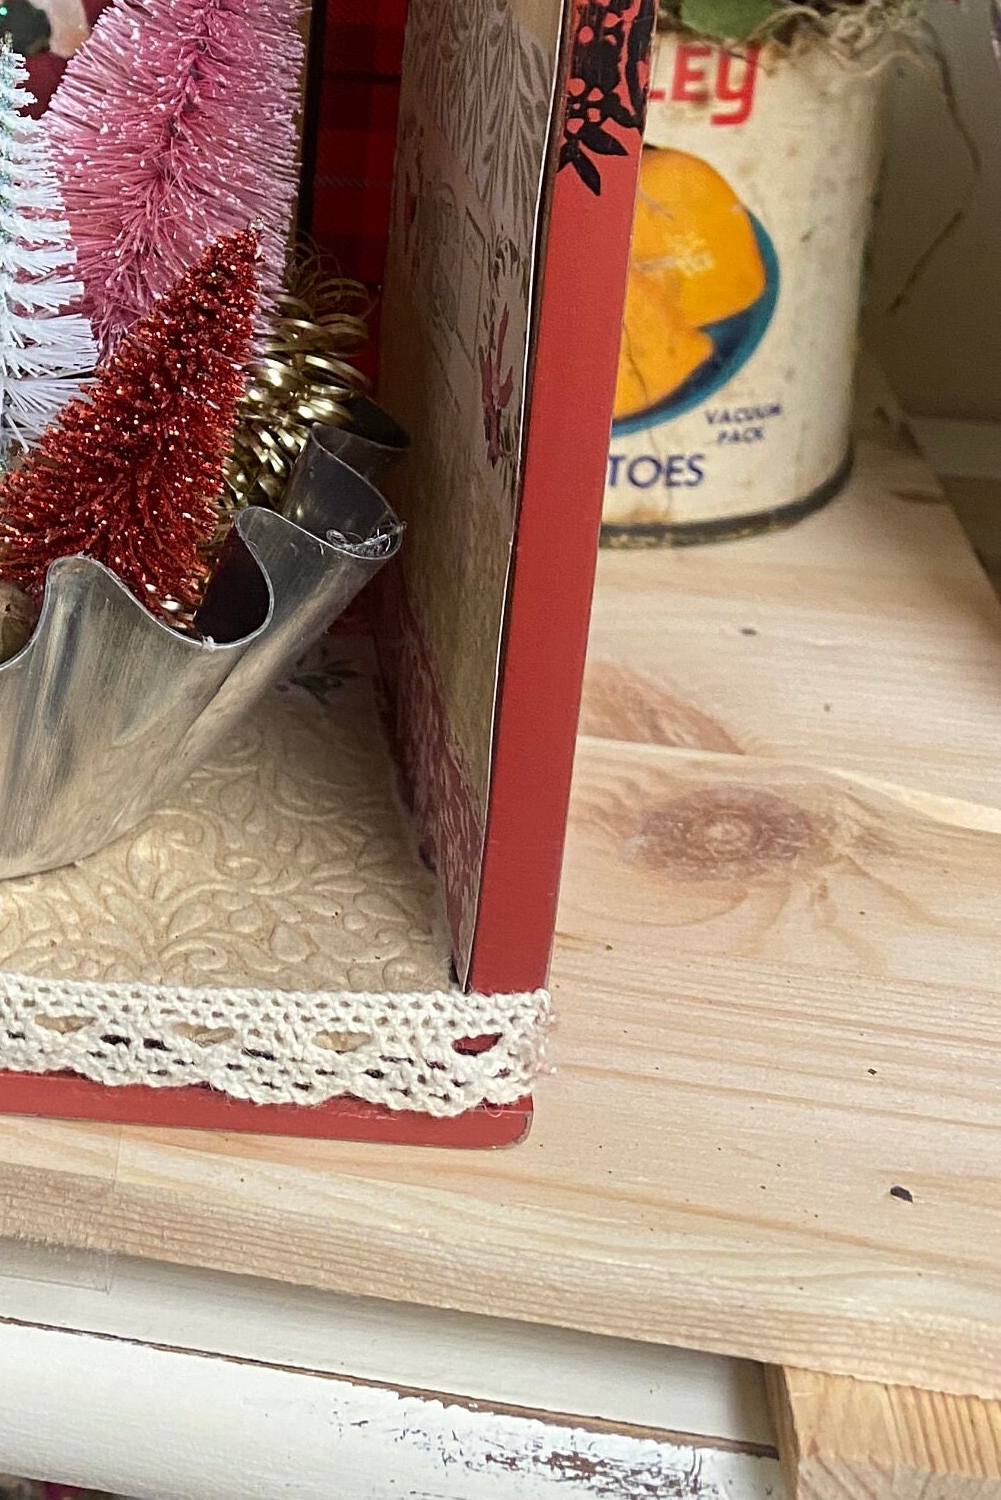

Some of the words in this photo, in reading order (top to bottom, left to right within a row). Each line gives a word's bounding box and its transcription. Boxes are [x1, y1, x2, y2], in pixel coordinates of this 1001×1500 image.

[648, 41, 759, 126] EY
[705, 403, 782, 425] VACUUM
[717, 426, 765, 445] PACK
